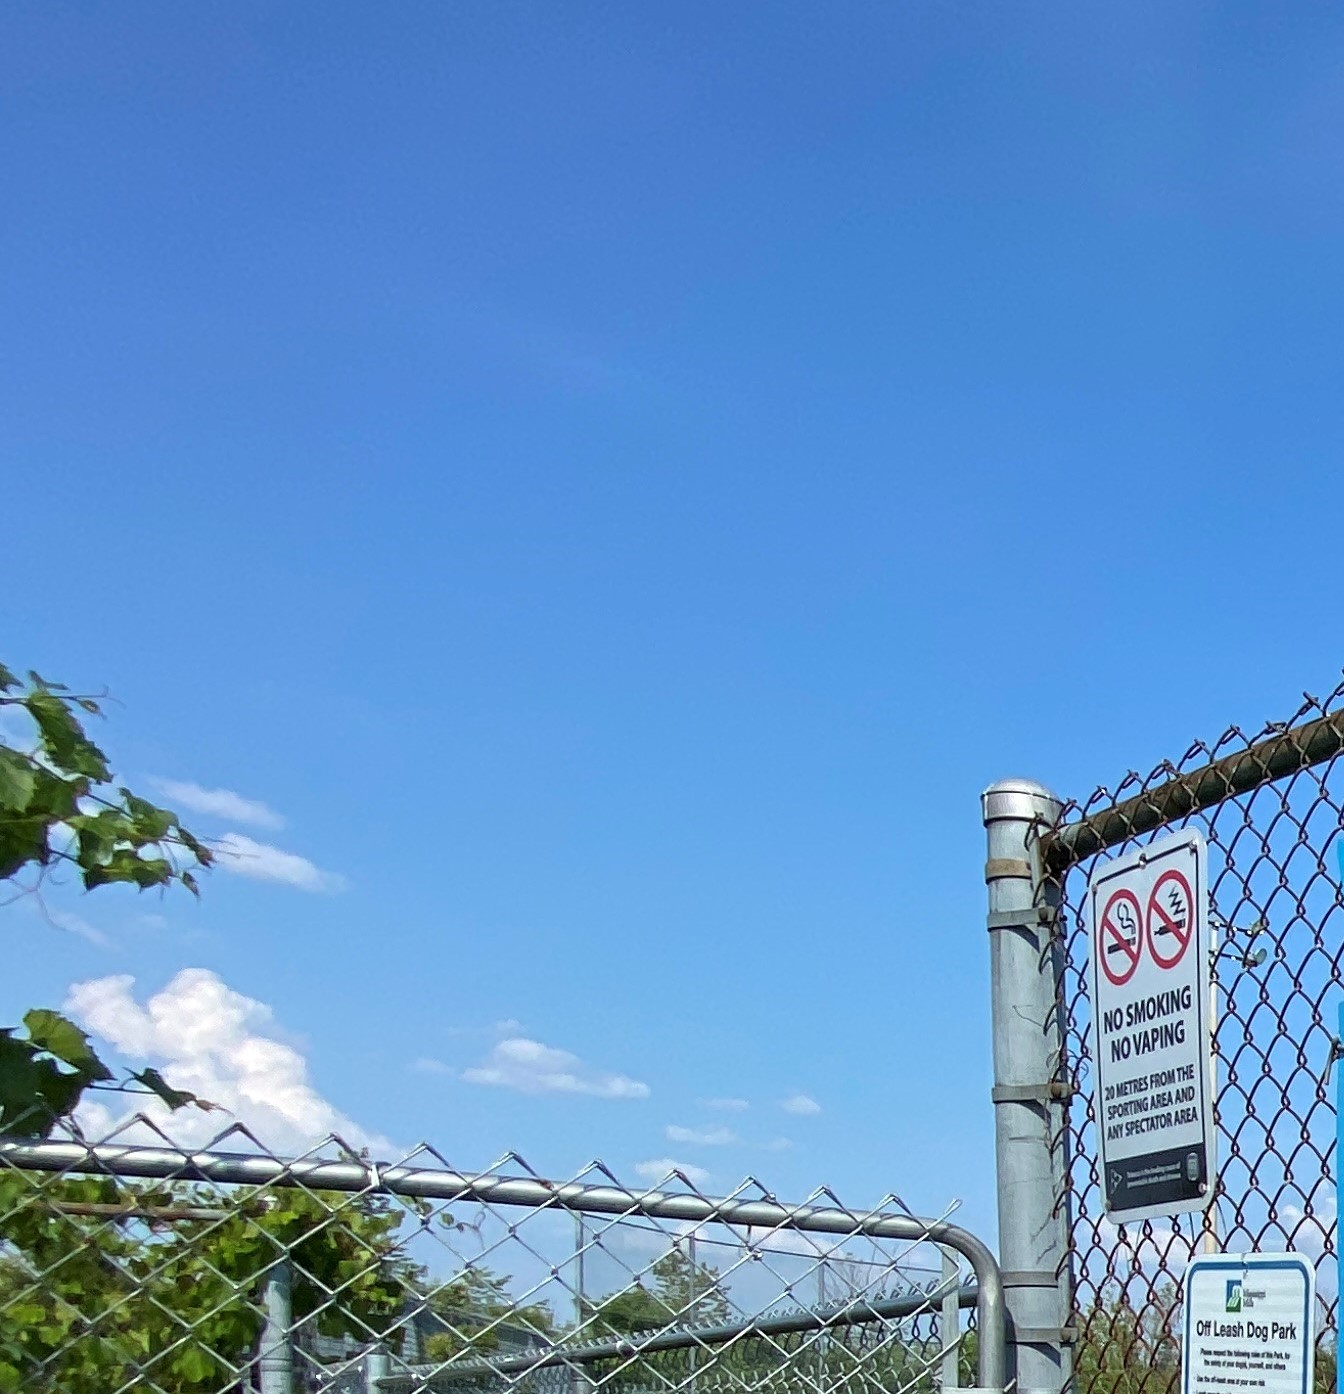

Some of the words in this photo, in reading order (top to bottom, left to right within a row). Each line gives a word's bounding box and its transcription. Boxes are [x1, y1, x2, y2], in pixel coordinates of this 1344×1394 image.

[1103, 1007, 1124, 1034] NO
[1126, 985, 1192, 1027] SMOKING
[1111, 1036, 1131, 1063] NO
[1132, 1020, 1185, 1056] VAPING
[1105, 1085, 1115, 1101] 20
[1116, 1076, 1149, 1099] METRES
[1150, 1069, 1176, 1090] FROM
[1177, 1064, 1195, 1082] THE
[1107, 1097, 1149, 1120] SPORTING
[1150, 1090, 1174, 1111] AREA
[1175, 1086, 1196, 1105] AND
[1107, 1123, 1124, 1141] ANY
[1125, 1112, 1173, 1137] SPECTATOR
[1174, 1106, 1199, 1127] AREA
[1196, 1320, 1212, 1337] Off
[1213, 1321, 1244, 1338] Leash
[1246, 1321, 1269, 1342] Dog
[1271, 1322, 1297, 1340] Park
